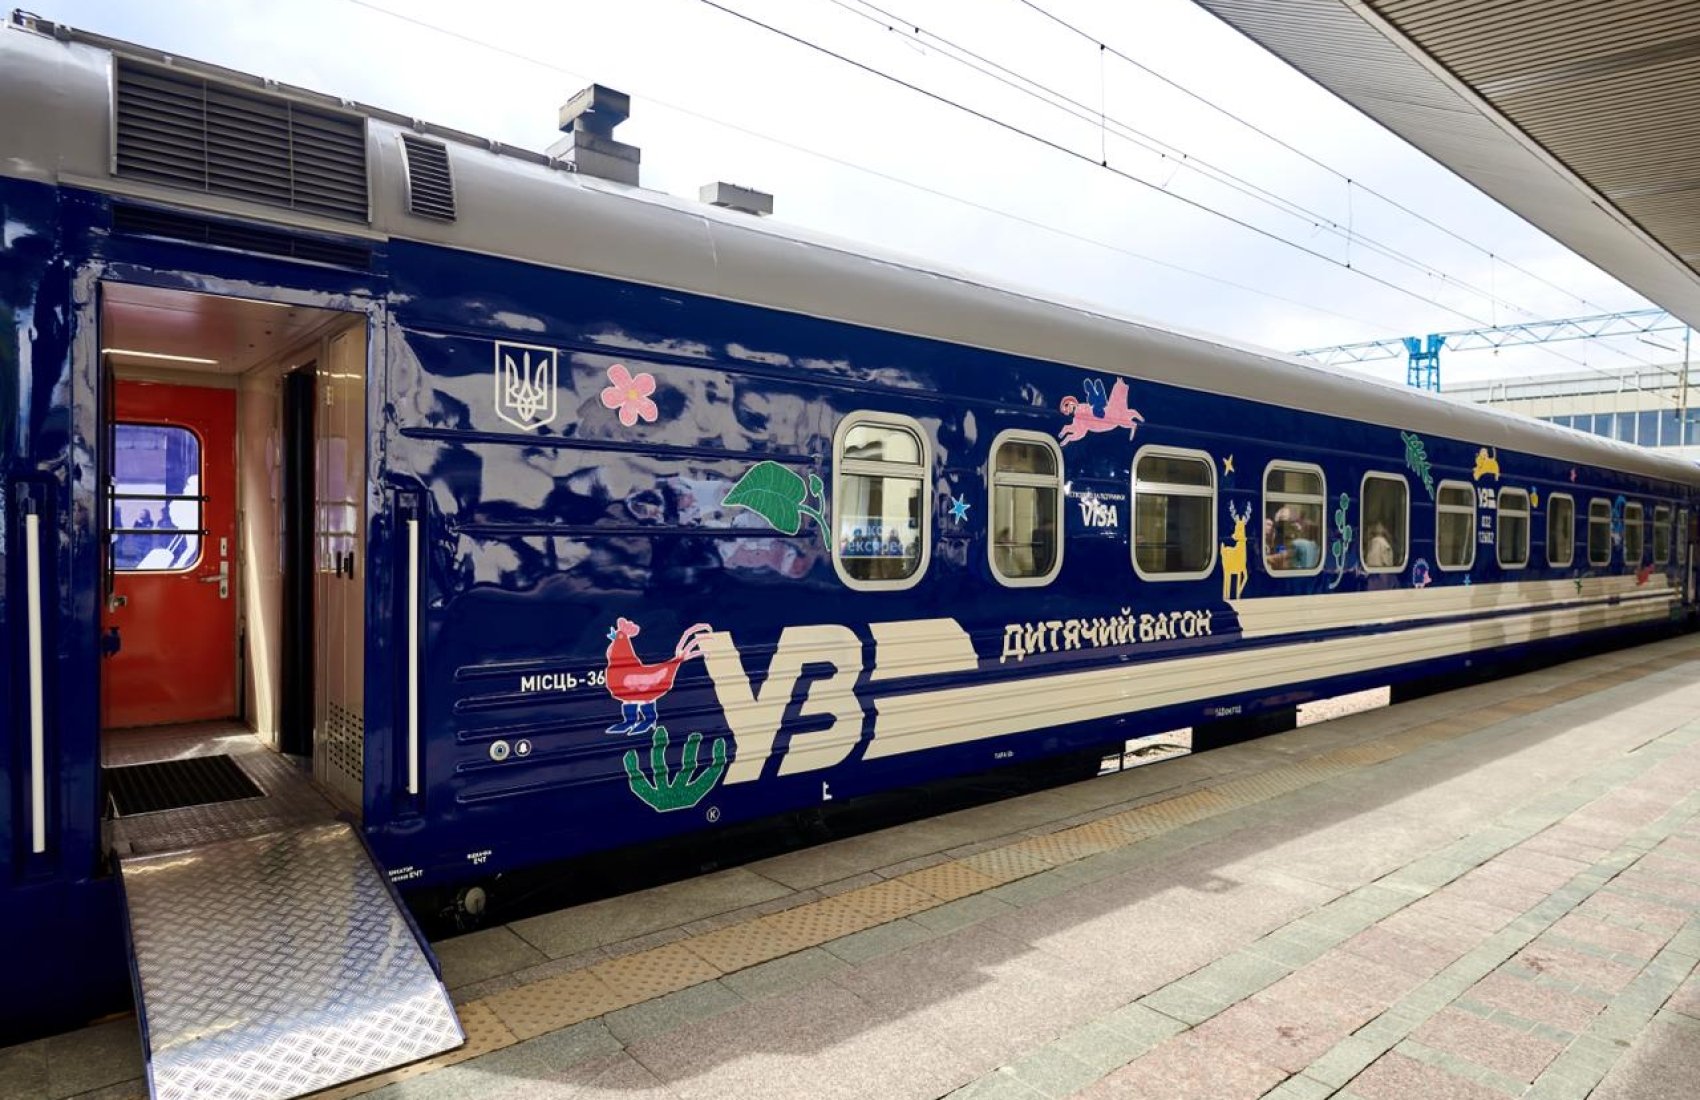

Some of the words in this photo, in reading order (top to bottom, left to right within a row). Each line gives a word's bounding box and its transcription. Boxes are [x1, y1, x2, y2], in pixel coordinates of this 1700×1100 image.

[1078, 502, 1118, 527] VISA
[1000, 606, 1137, 664] ДИТЯЧИЙ
[1139, 609, 1213, 643] ВАГОН
[521, 670, 606, 693] МІСЦЬ-36
